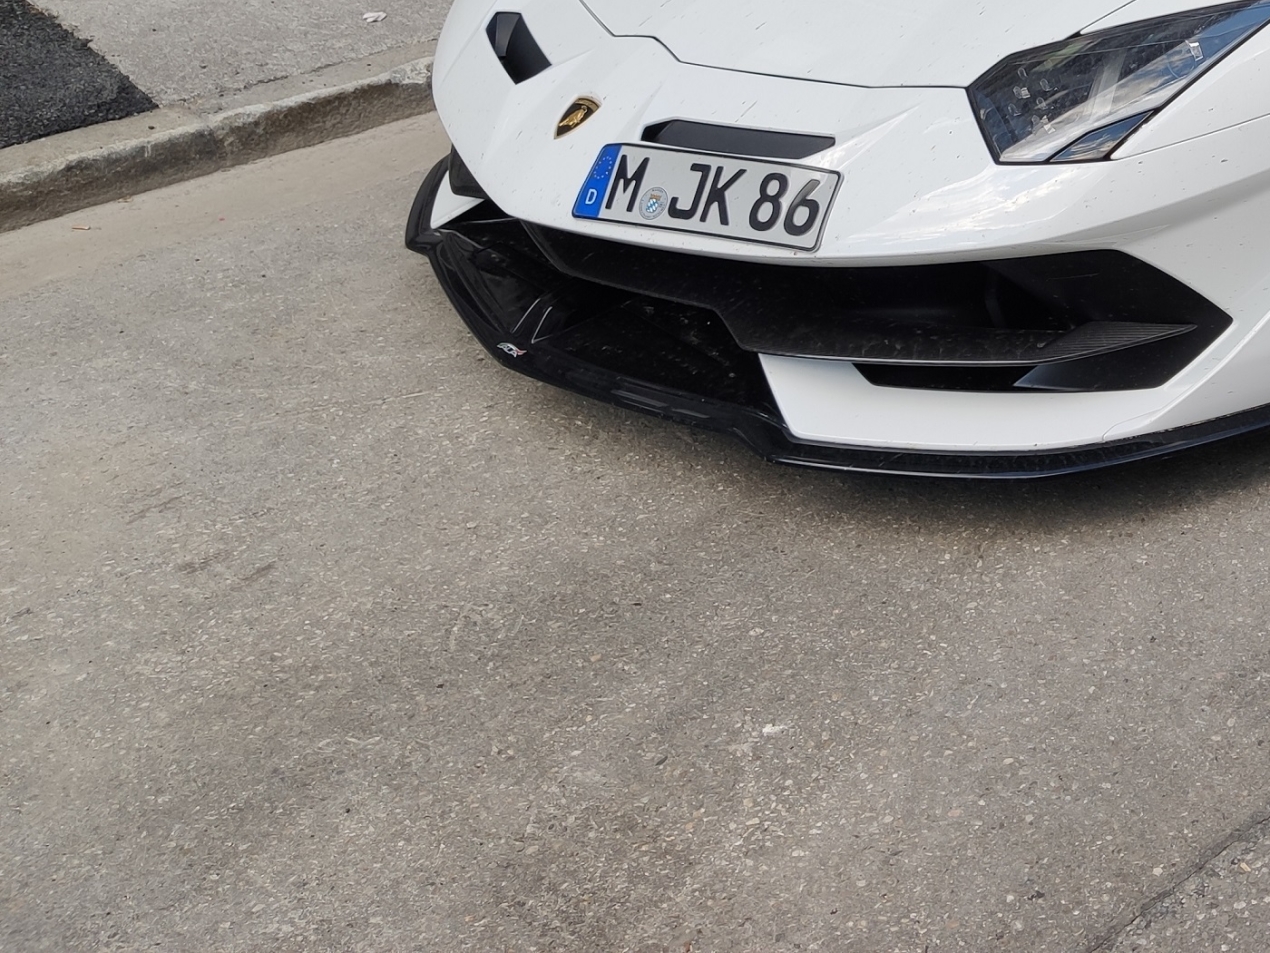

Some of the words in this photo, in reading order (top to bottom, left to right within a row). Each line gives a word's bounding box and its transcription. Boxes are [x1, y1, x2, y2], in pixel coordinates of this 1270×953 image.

[584, 188, 597, 205] D
[605, 154, 650, 212] M
[668, 163, 747, 226] JK
[748, 173, 820, 236] 86
